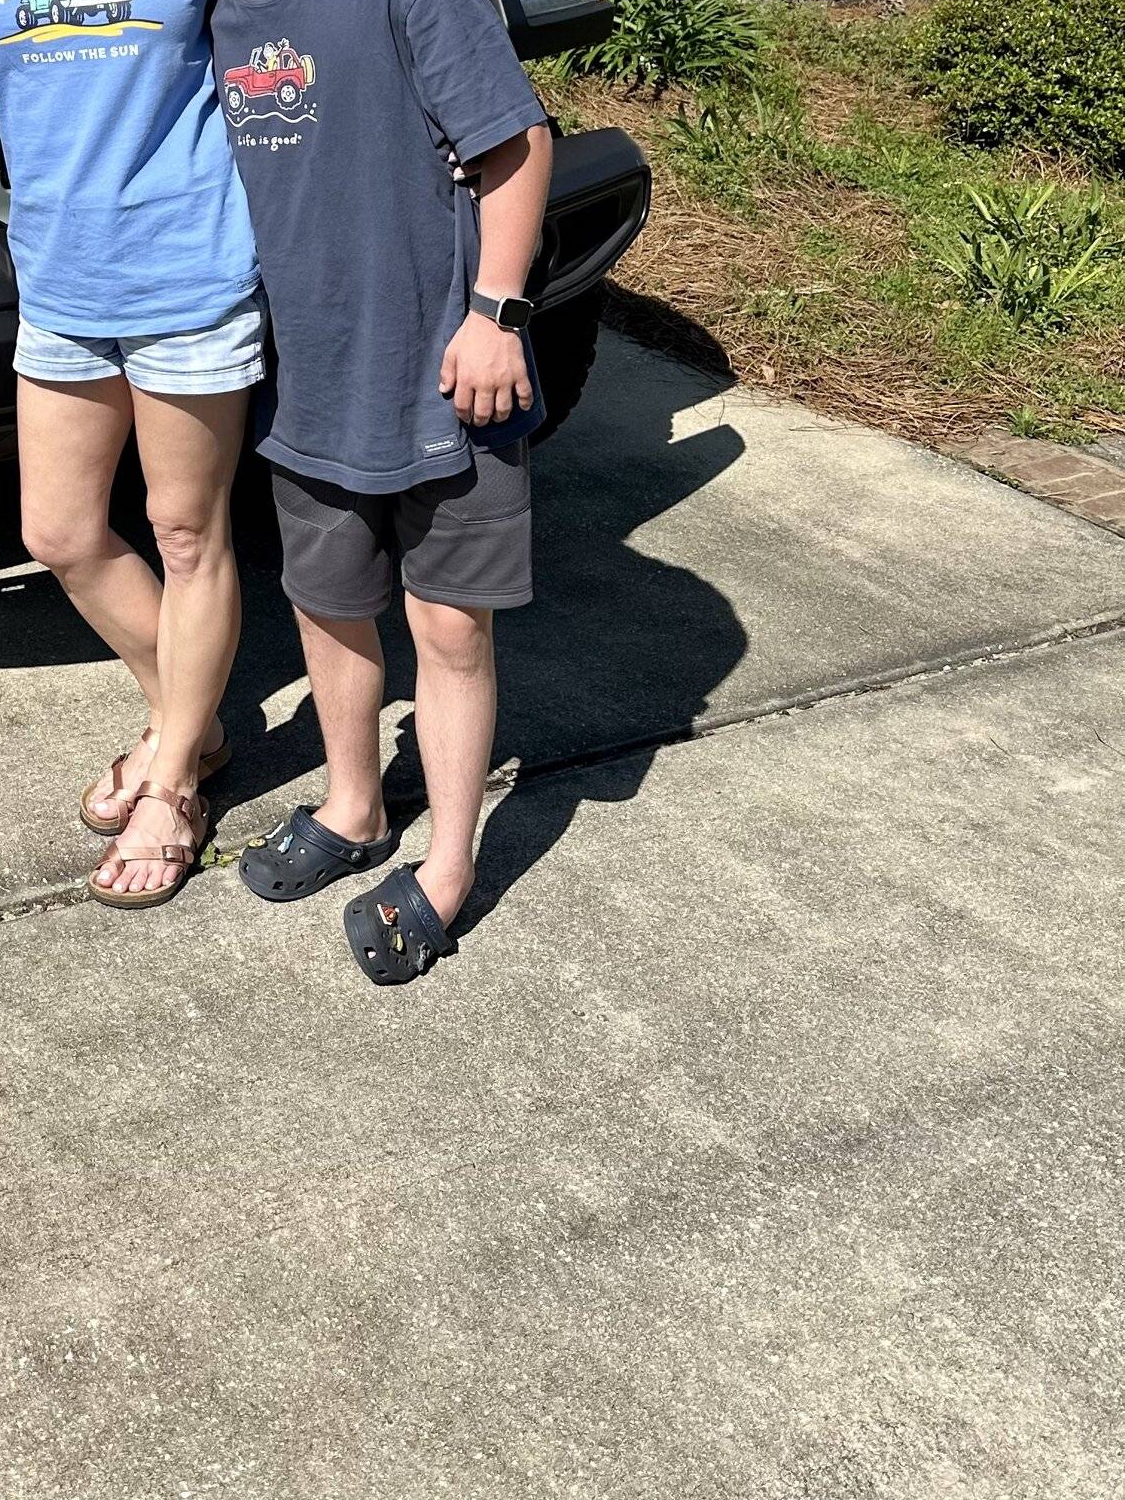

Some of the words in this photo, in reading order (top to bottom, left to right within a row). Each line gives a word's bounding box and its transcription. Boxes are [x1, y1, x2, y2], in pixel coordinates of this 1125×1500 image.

[21, 50, 75, 63] FOLLOW
[78, 47, 107, 61] THE
[109, 44, 139, 58] SUN
[237, 133, 257, 147] Life
[258, 135, 269, 145] is
